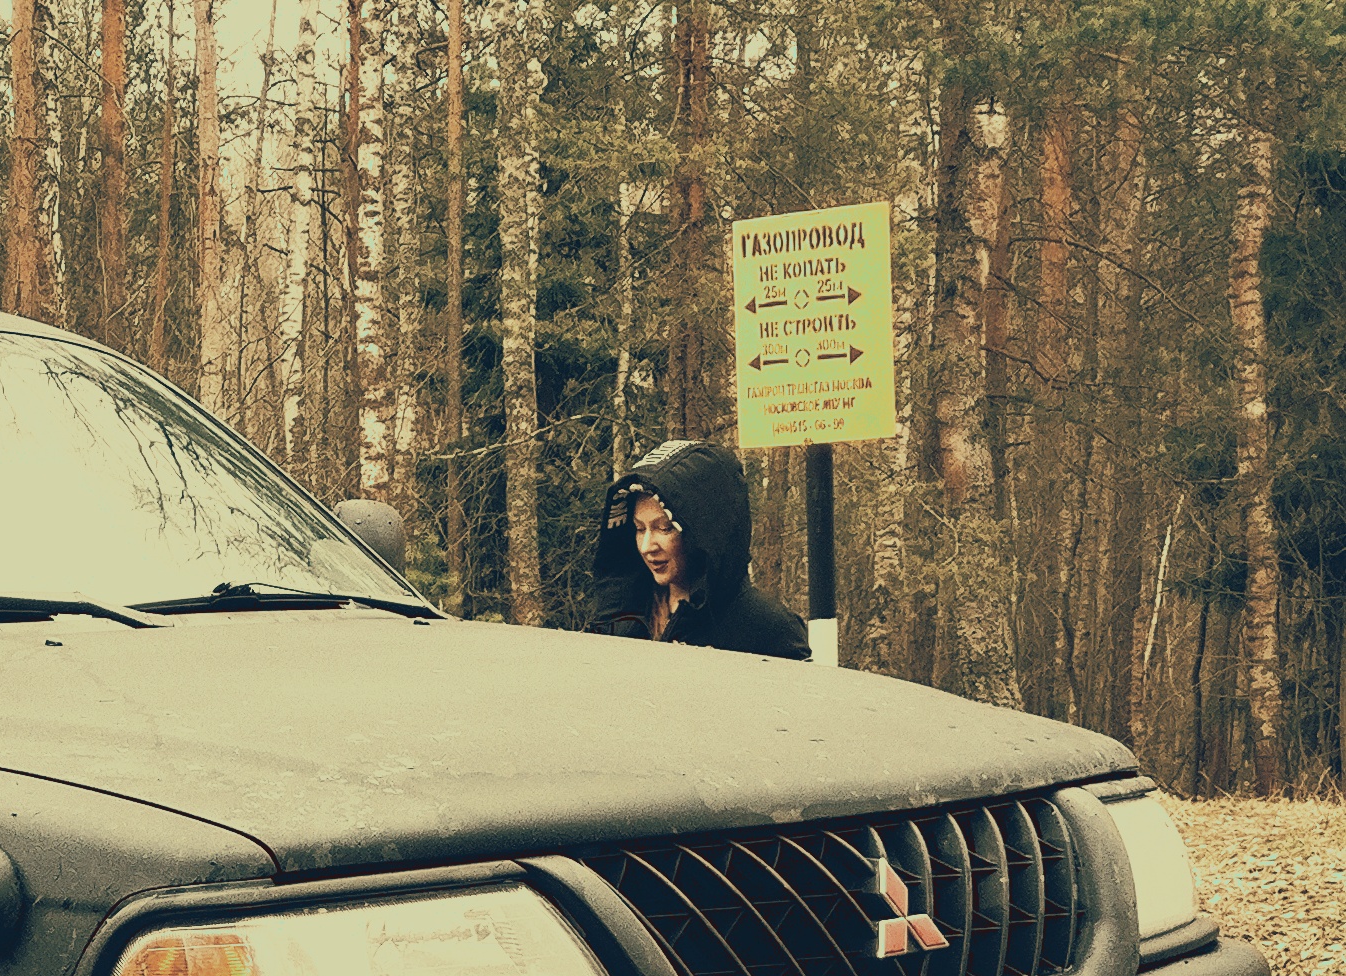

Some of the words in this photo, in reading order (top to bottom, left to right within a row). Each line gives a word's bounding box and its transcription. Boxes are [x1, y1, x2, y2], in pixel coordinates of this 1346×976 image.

[740, 221, 866, 258] ГАЗОПРОВОД
[759, 264, 779, 282] НЕ
[782, 257, 847, 280] КОПАТЬ
[759, 321, 779, 339] НЕ
[783, 313, 857, 336] СТРОИТЬ
[832, 376, 872, 392] МОСКВА
